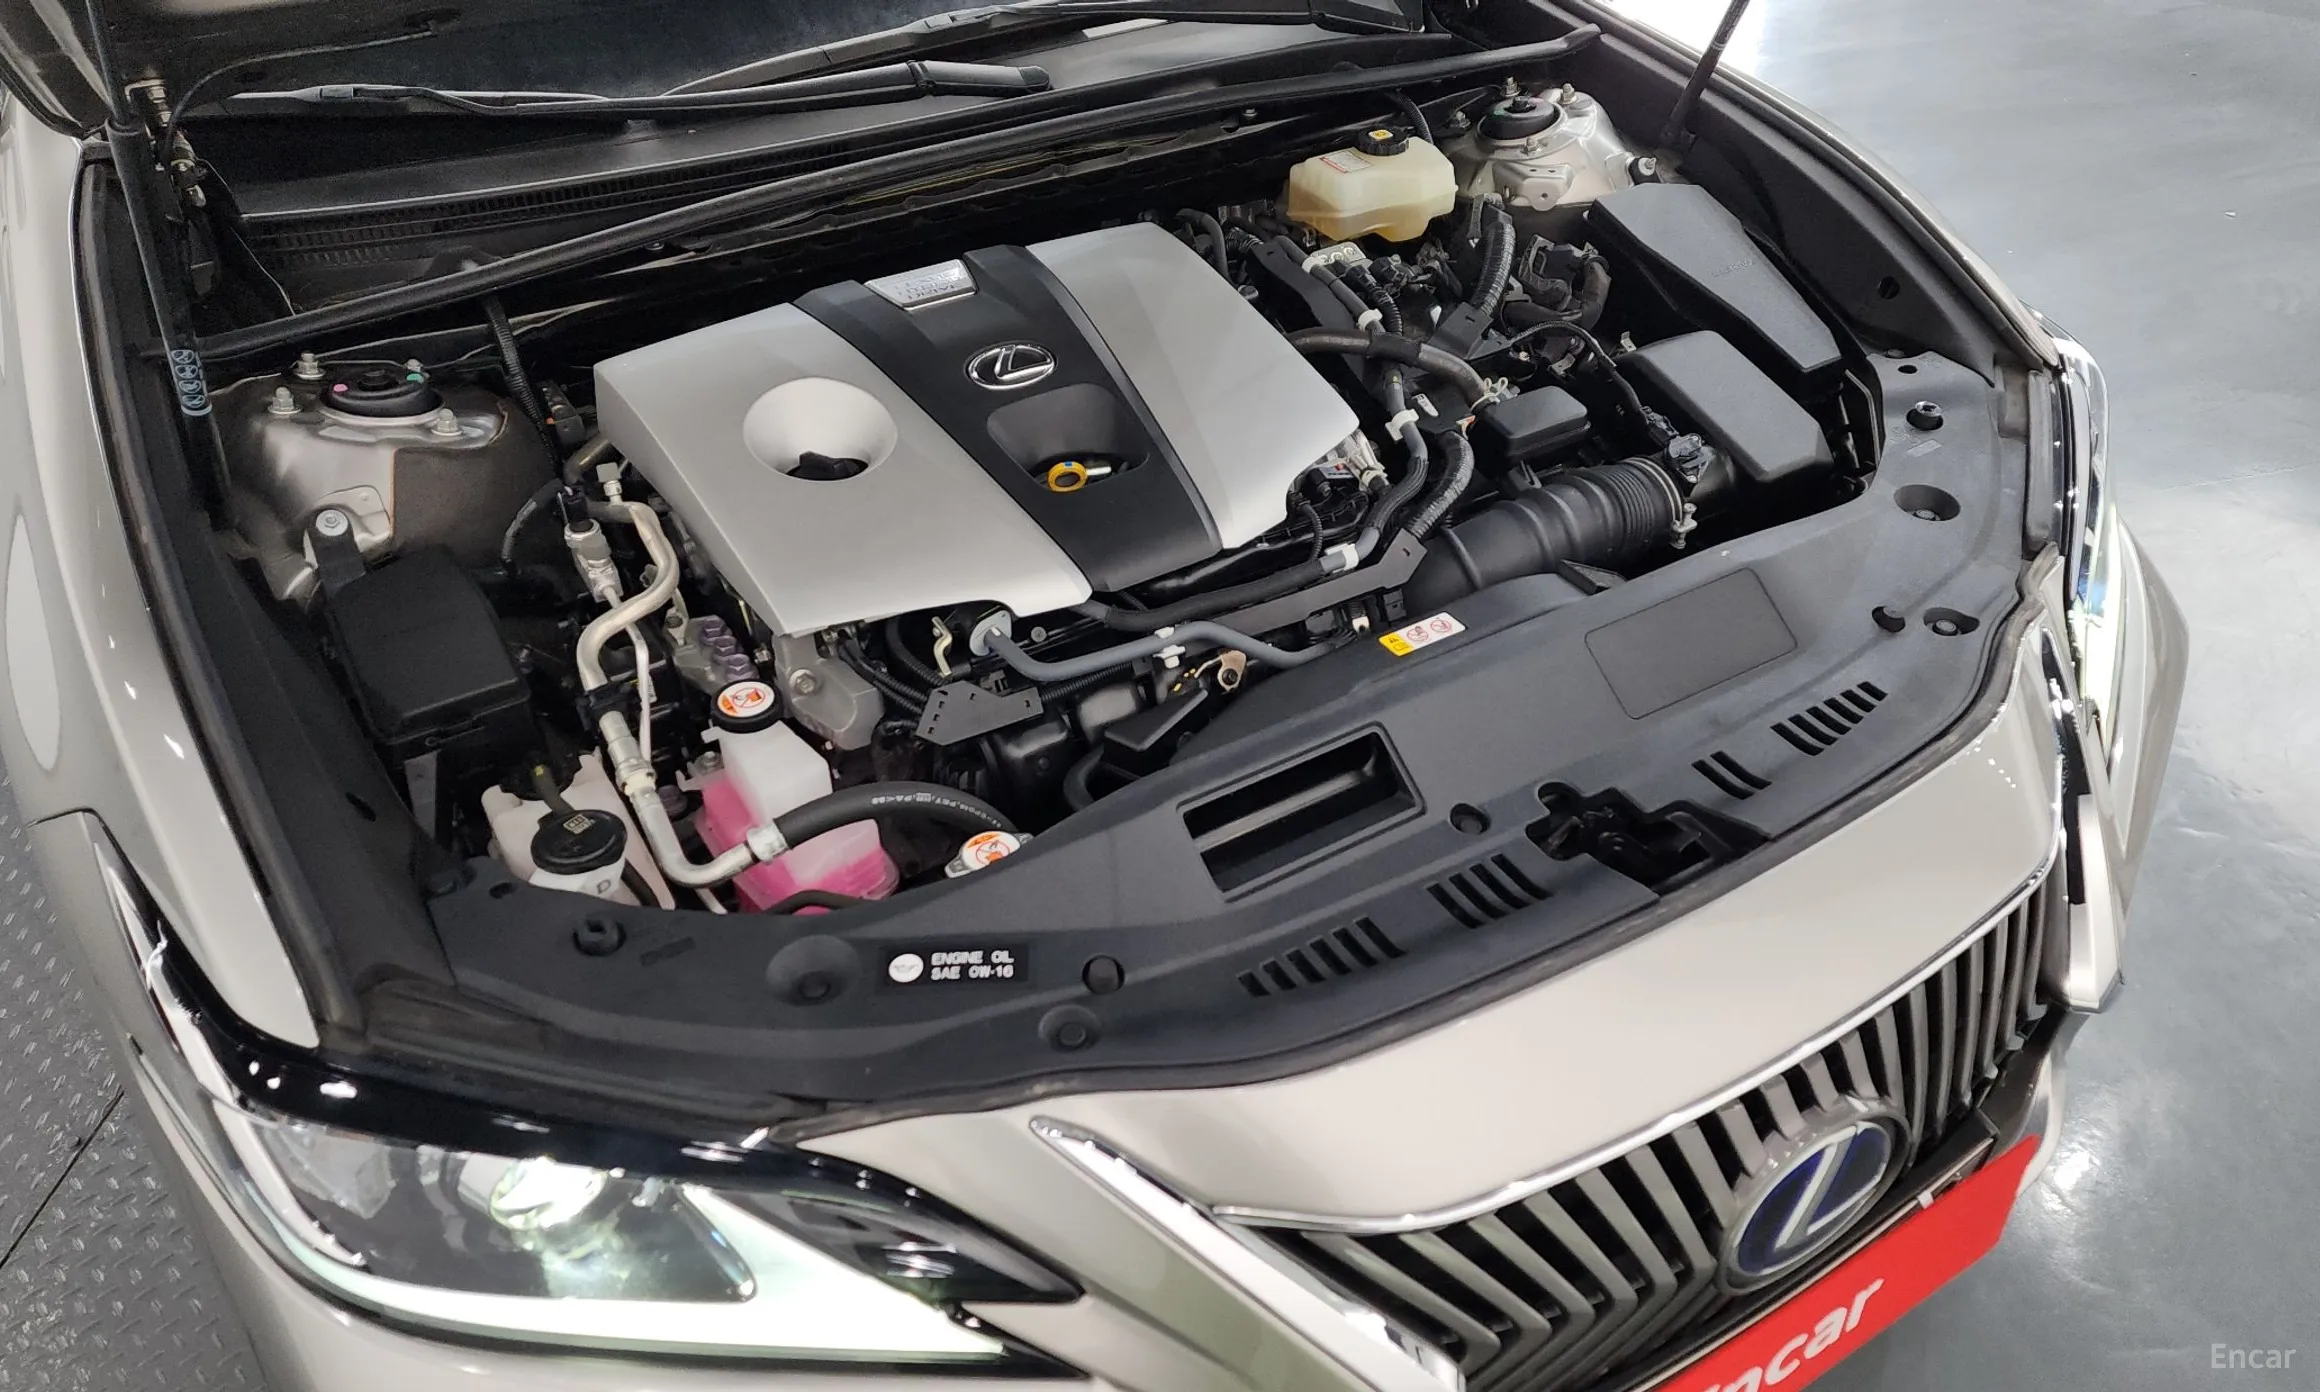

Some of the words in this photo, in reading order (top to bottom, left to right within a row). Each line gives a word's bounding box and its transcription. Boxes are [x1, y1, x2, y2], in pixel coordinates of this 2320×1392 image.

[931, 951, 983, 966] ENGINE
[991, 950, 1015, 964] OIL
[931, 966, 961, 981] SAE
[1703, 1278, 1884, 1392] ncar
